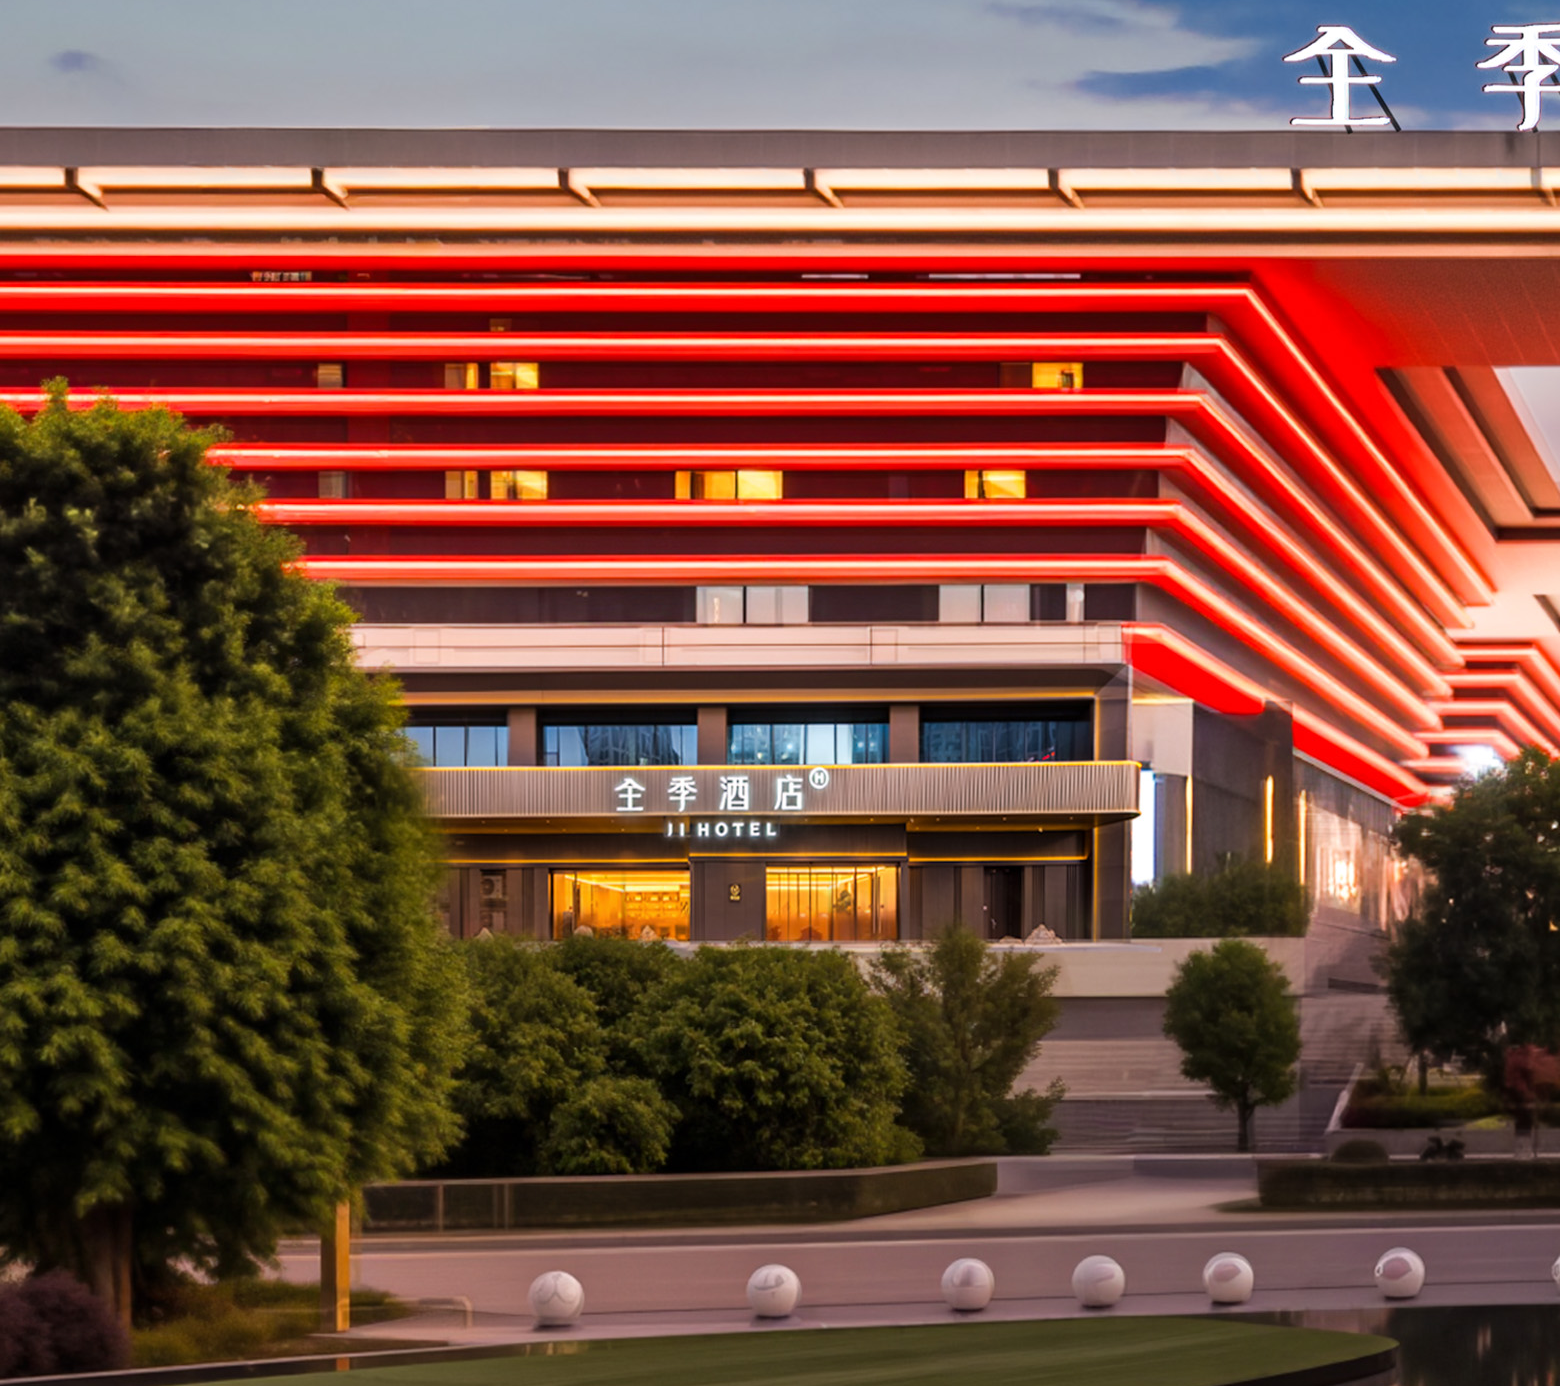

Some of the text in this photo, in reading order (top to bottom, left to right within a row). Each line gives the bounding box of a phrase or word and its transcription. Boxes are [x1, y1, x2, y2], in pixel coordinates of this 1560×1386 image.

[614, 774, 803, 812] 全季酒店
[667, 822, 777, 837] JI HOTEL
